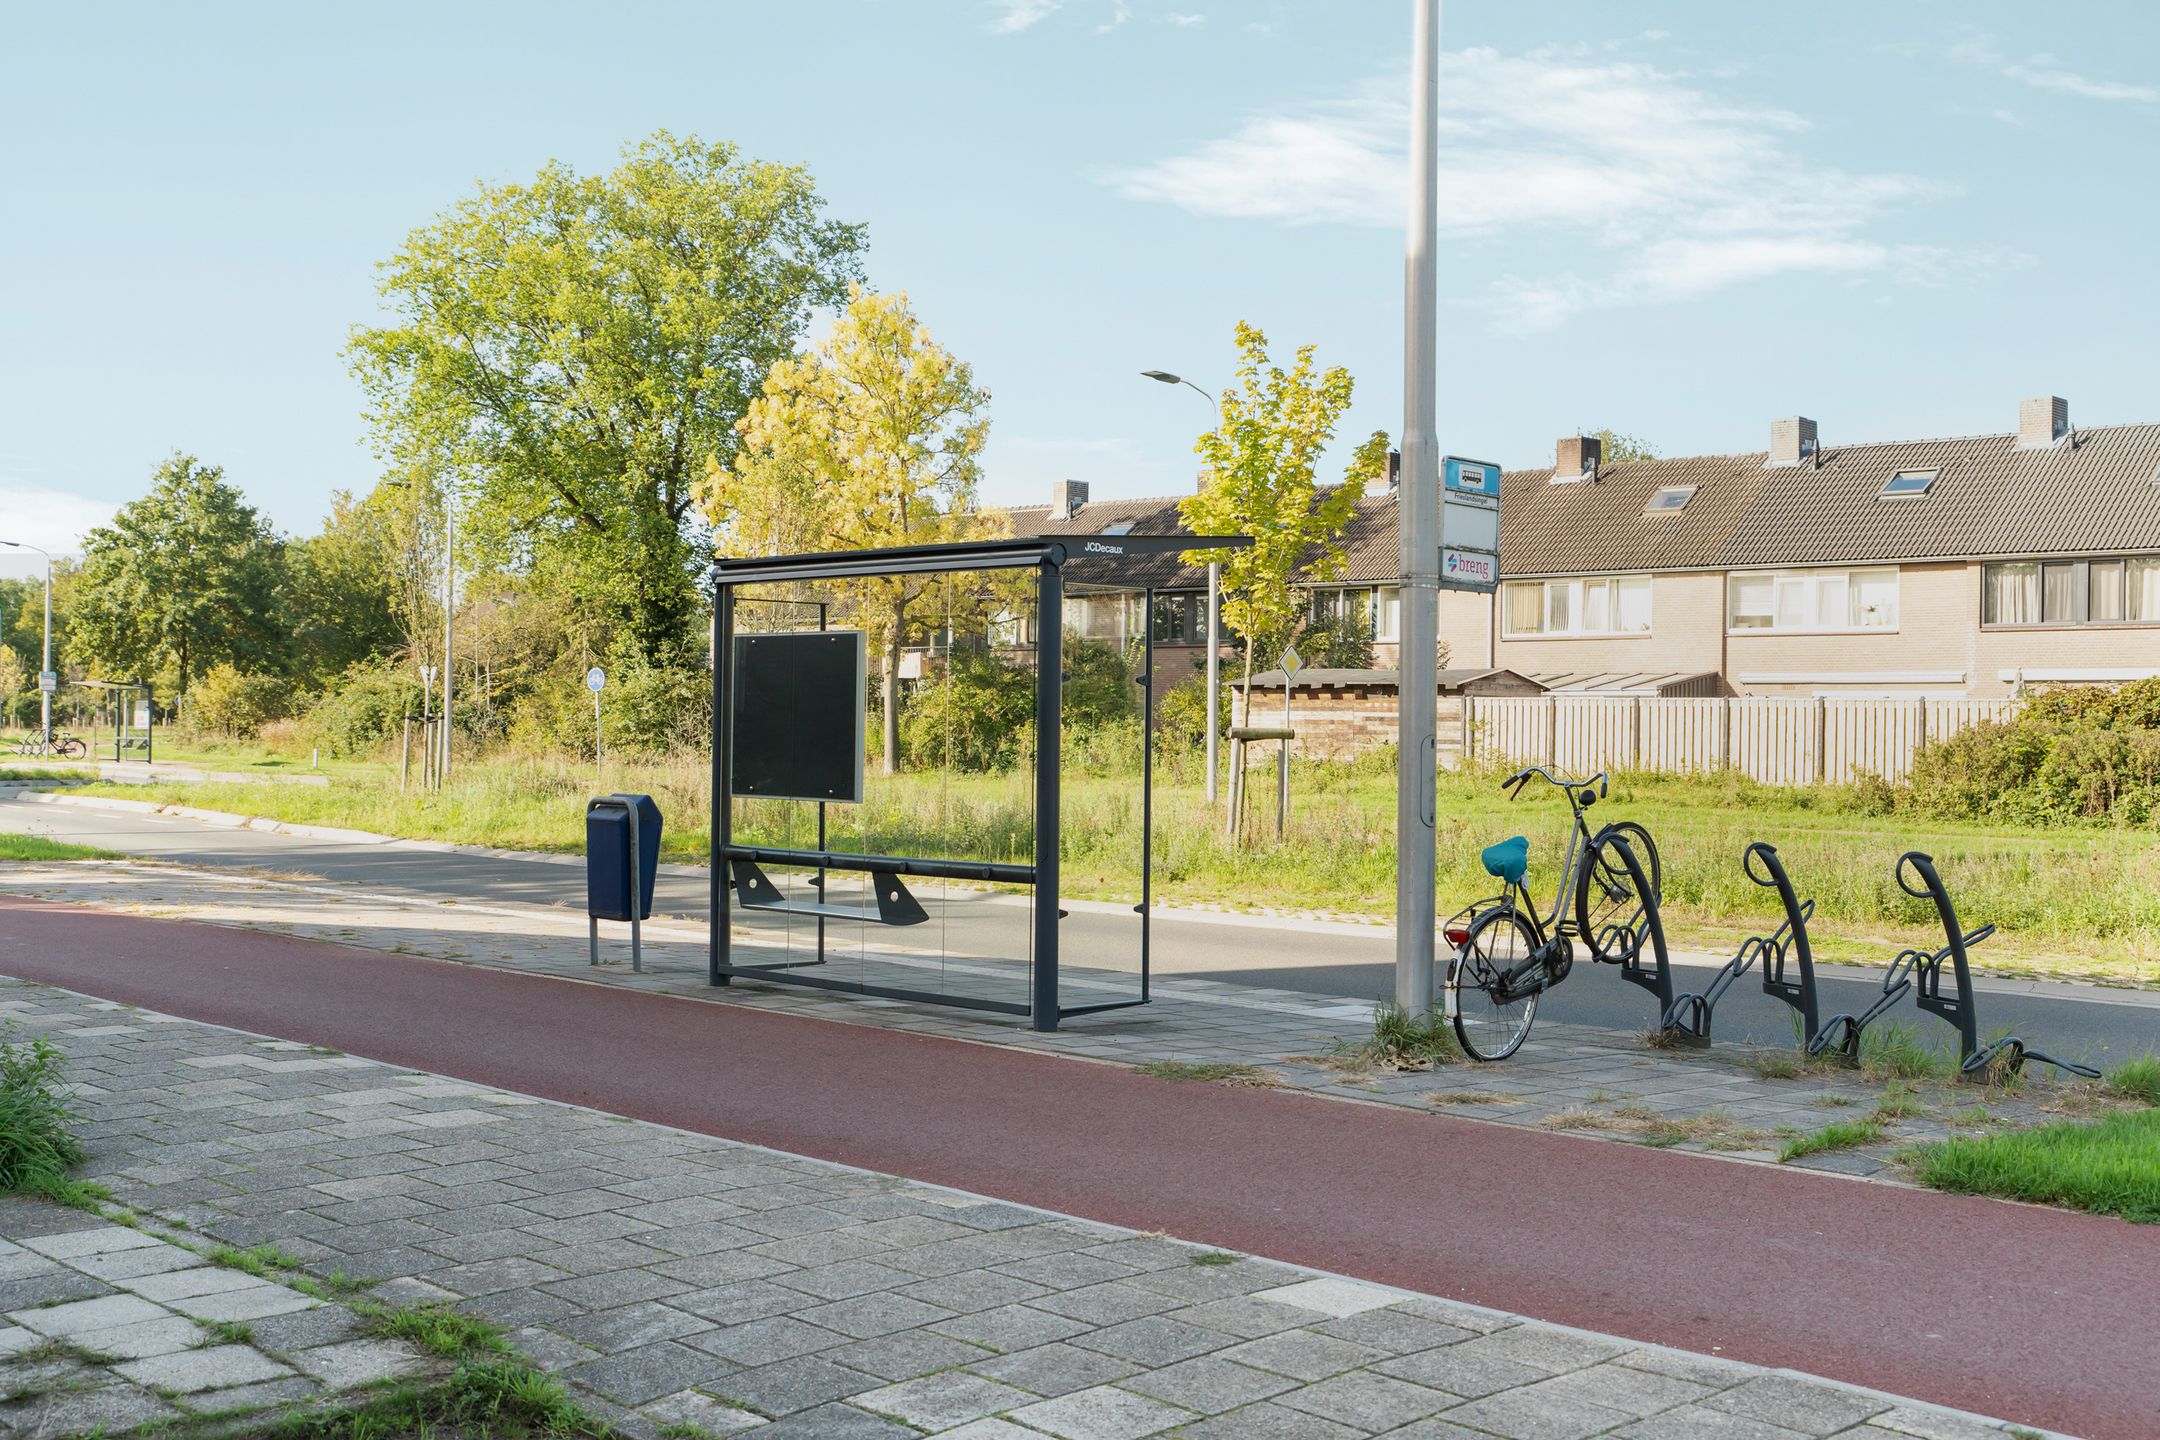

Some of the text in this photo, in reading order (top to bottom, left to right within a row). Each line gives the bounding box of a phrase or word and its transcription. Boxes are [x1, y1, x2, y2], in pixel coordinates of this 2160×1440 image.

[1454, 492, 1488, 505] Frieslandsingel
[1084, 541, 1124, 554] JCDecaux
[1459, 554, 1489, 579] breng
